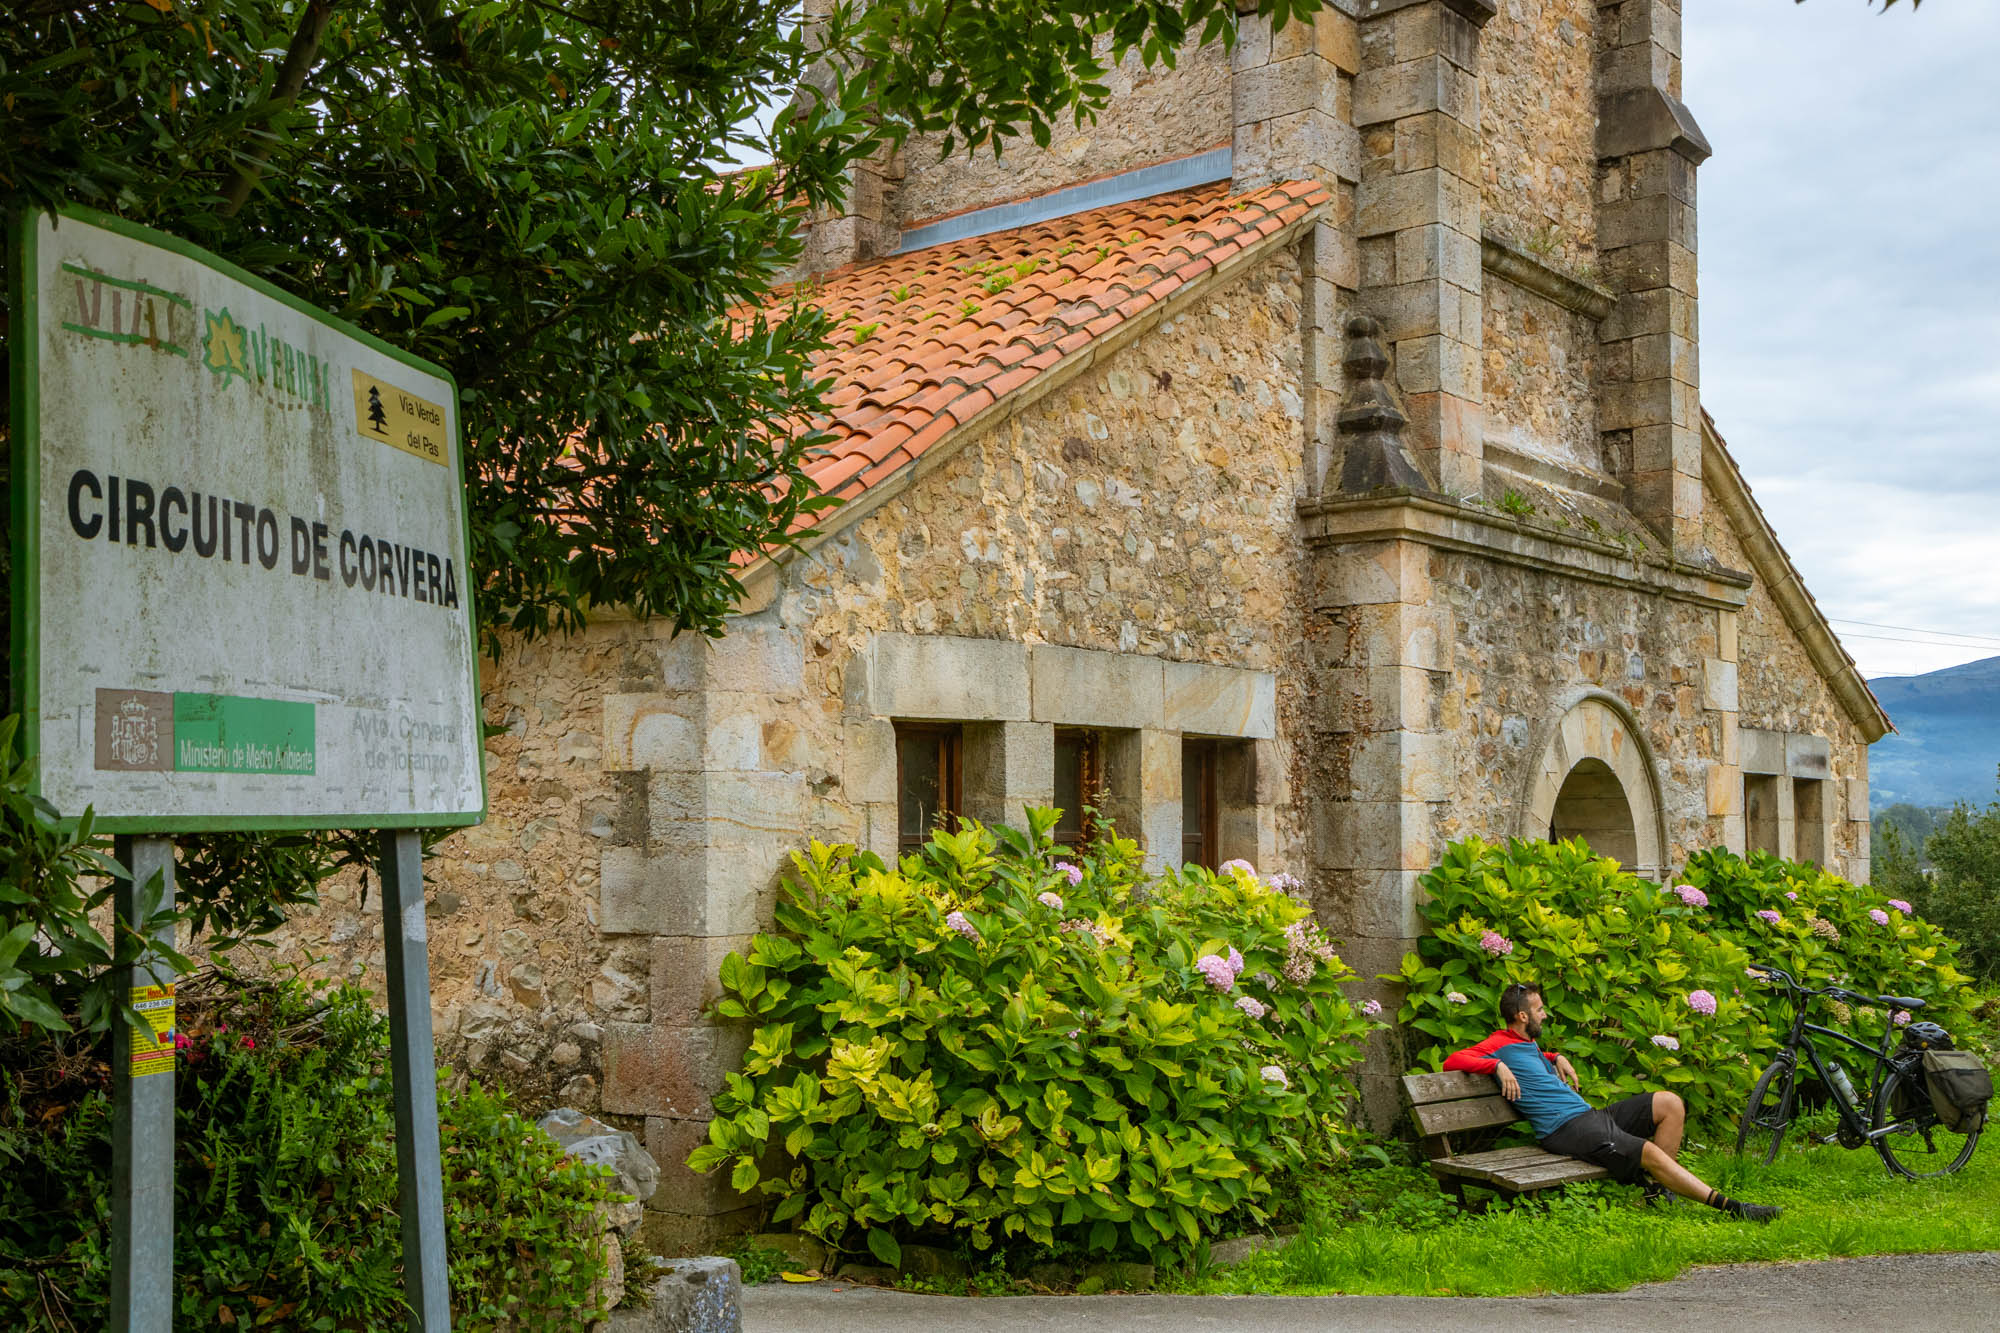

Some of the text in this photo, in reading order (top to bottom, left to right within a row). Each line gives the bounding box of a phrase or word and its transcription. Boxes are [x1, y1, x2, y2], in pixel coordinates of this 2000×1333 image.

[415, 402, 440, 426] Verde
[407, 431, 439, 456] del Pas
[67, 469, 459, 610] CIRCUITO DE CORVERA
[180, 739, 313, 771] Ministerio de Medio Ambiente
[364, 743, 449, 772] de Toranzo
